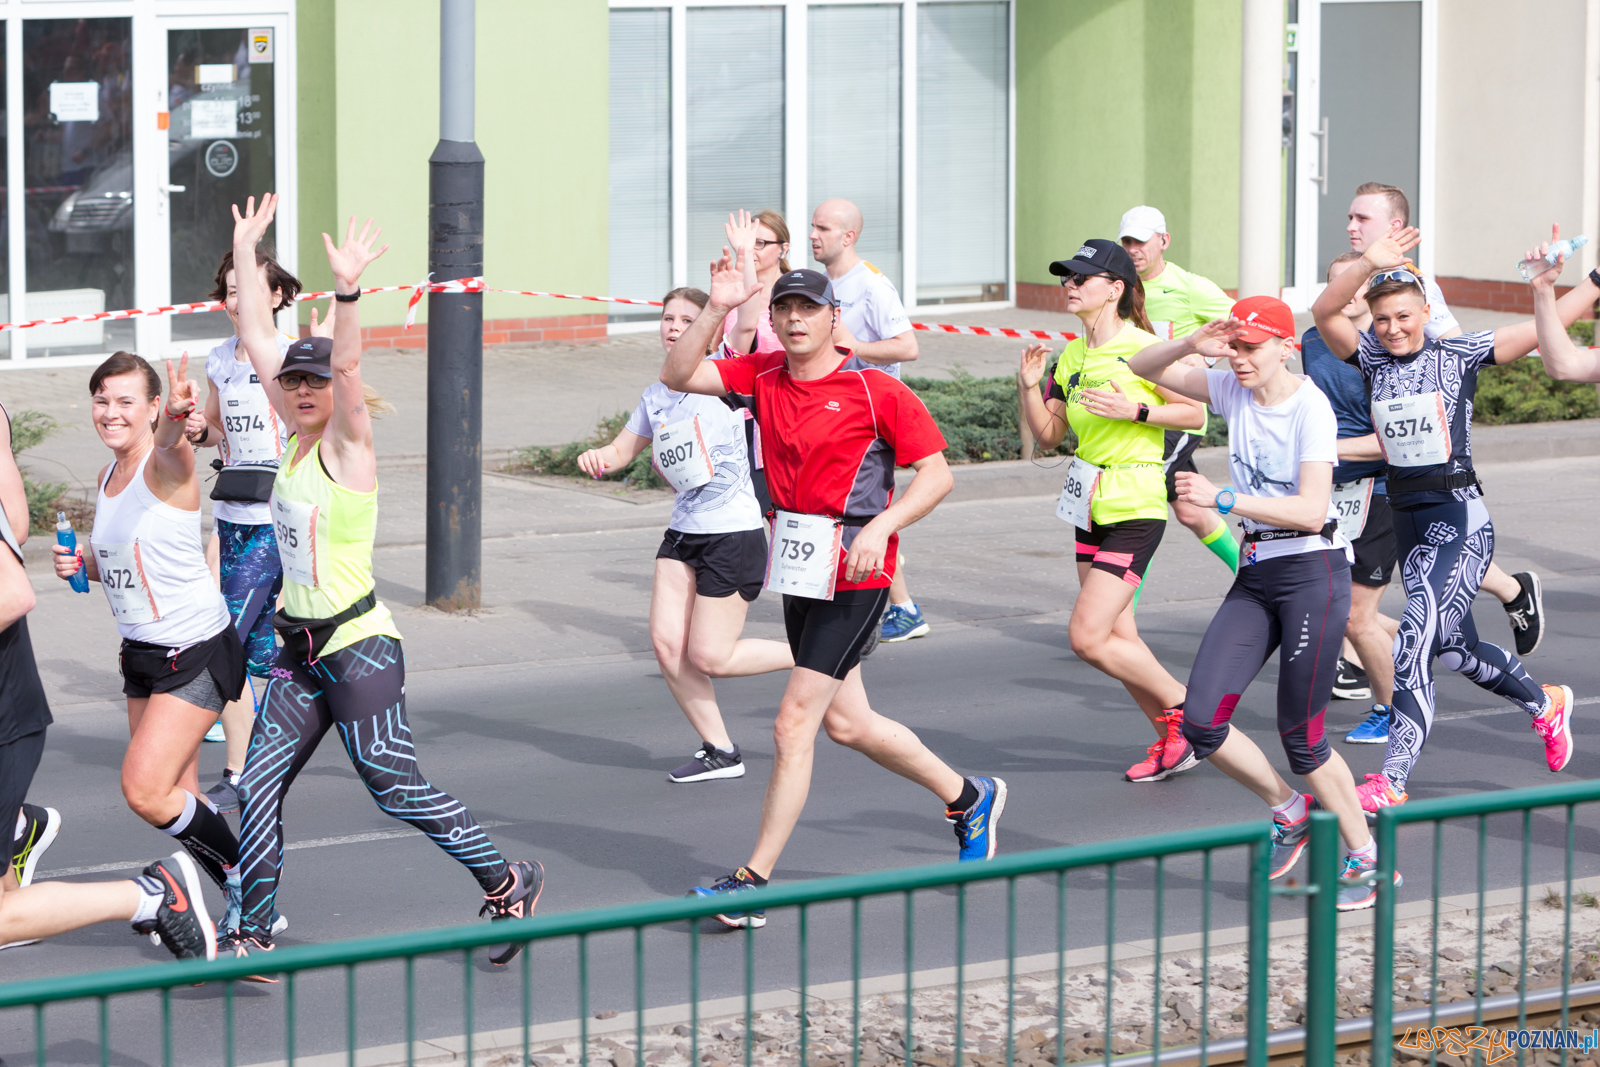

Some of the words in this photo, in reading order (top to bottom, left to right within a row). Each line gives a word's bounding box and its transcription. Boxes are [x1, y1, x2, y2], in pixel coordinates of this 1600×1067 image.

[225, 415, 264, 432] 8374
[1384, 417, 1433, 438] 6374
[660, 441, 693, 468] 8807
[277, 520, 298, 548] 595
[780, 538, 815, 561] 739
[781, 563, 807, 572] Sylwester
[101, 568, 135, 589] 4672
